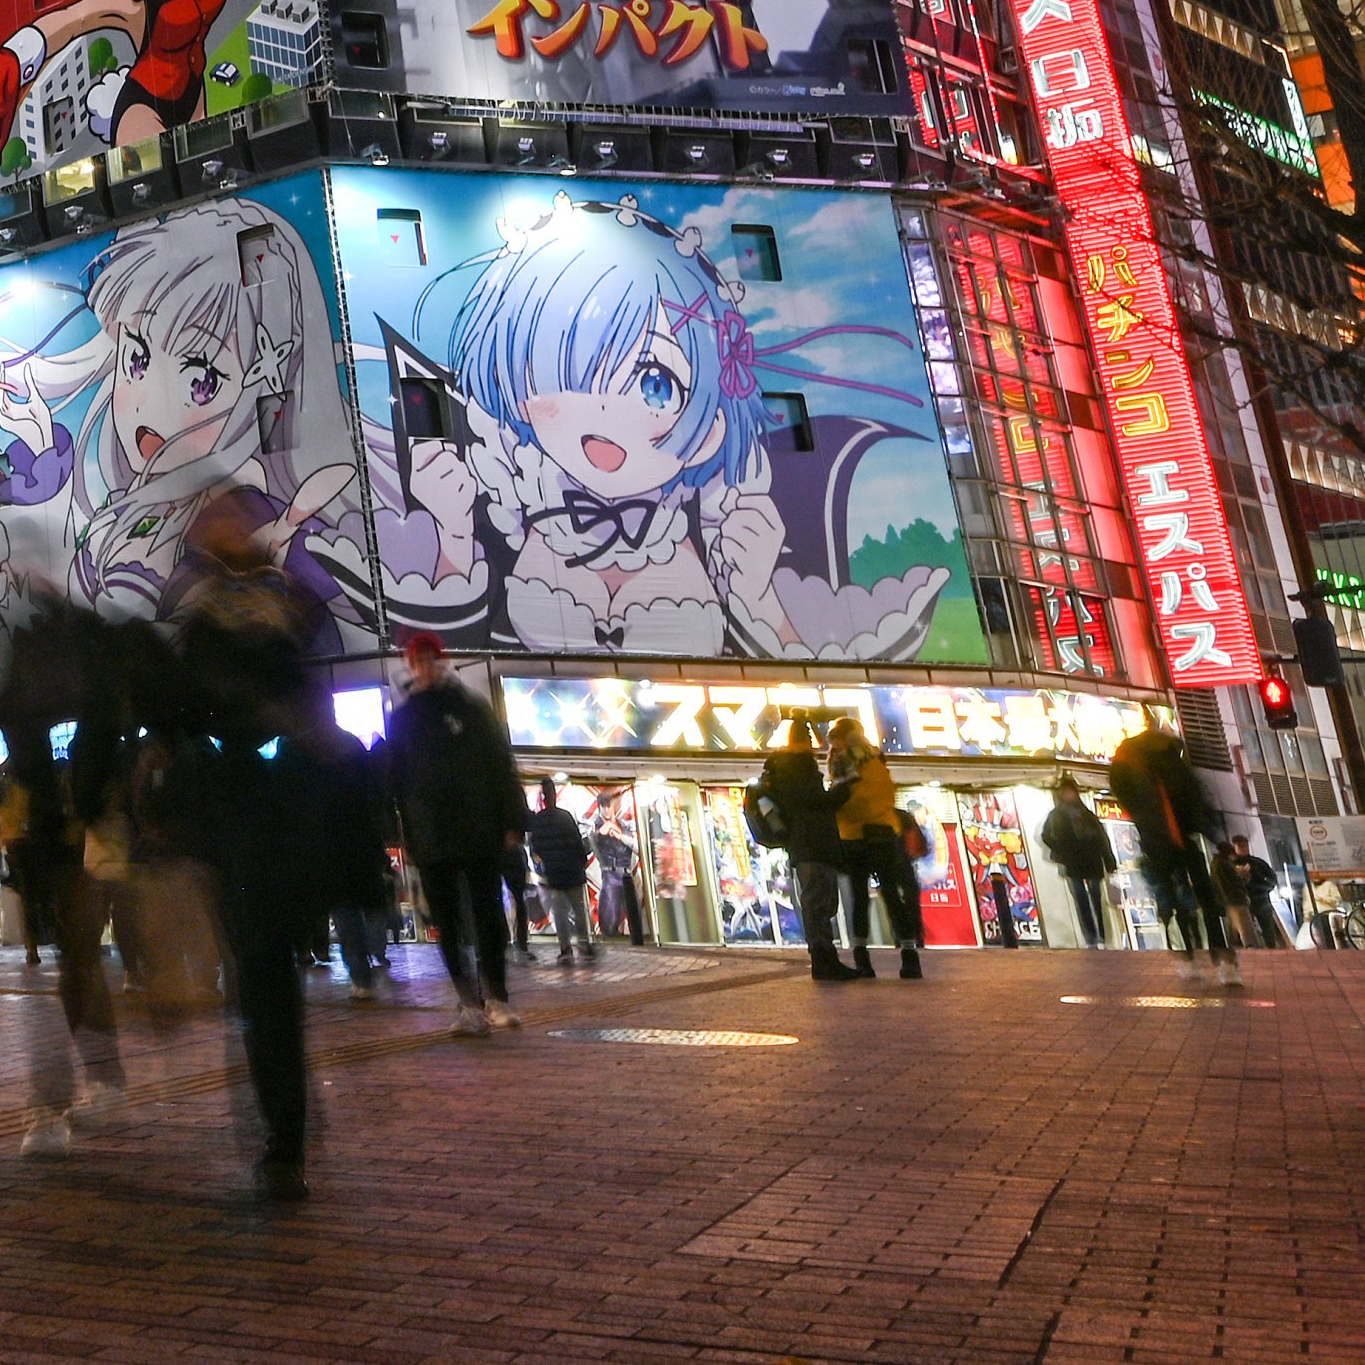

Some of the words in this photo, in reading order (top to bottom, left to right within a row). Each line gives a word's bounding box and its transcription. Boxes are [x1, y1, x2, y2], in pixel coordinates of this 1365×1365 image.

[1031, 49, 1105, 149] 日拓
[1085, 243, 1170, 437] パチンコ
[1132, 461, 1235, 672] エスパス
